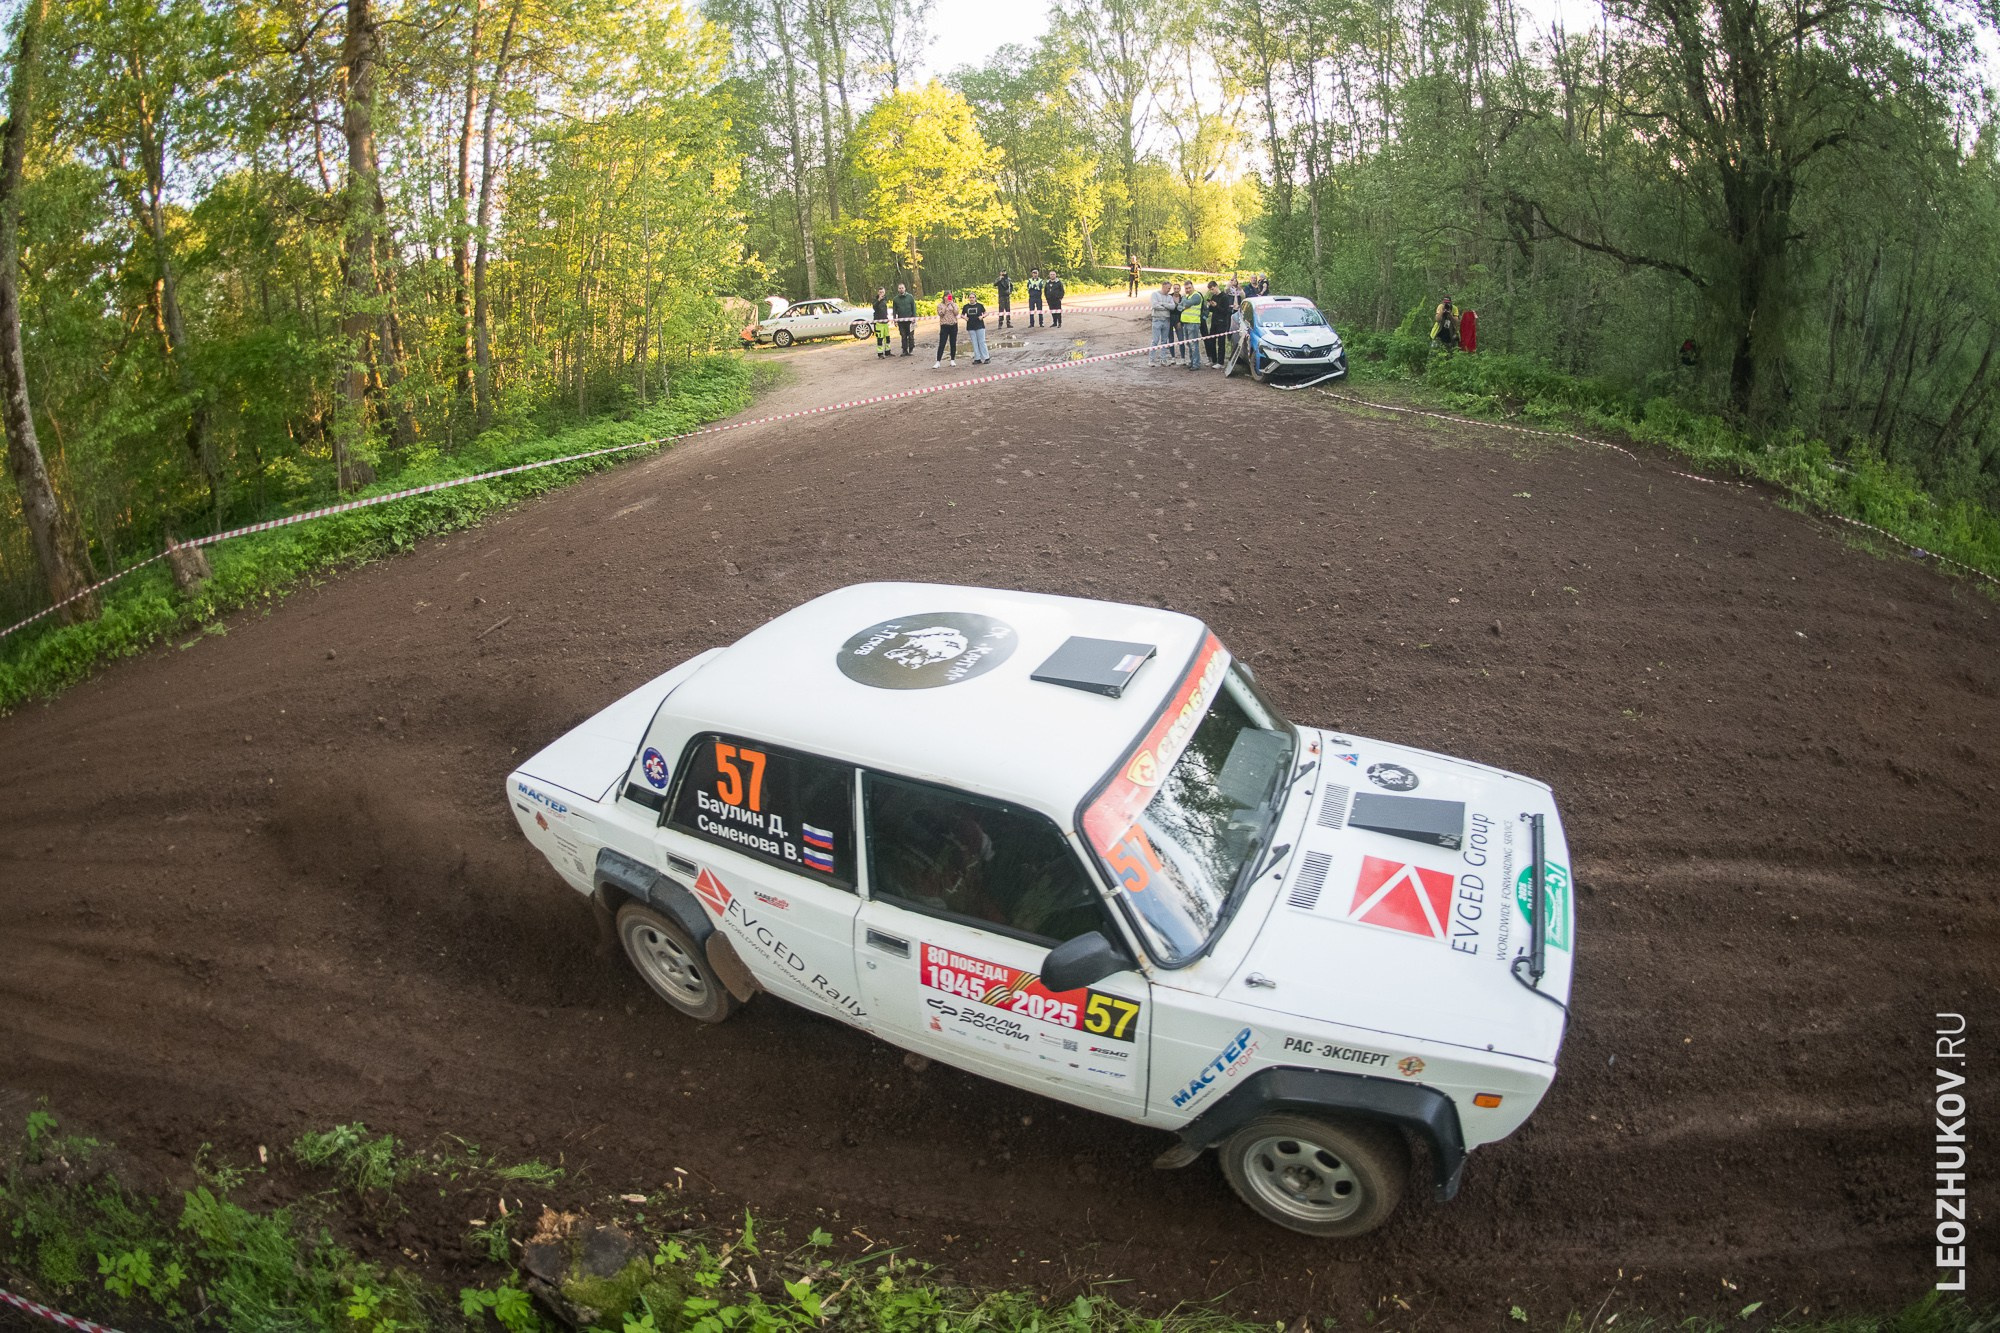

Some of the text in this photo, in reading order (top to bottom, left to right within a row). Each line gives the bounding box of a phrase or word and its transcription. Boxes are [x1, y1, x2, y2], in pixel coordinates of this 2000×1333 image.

[518, 782, 568, 813] МАСТЕР
[715, 743, 767, 812] 57
[697, 790, 789, 840] Баулин Д.
[697, 814, 803, 863] Семенова В.
[1104, 823, 1163, 893] 57
[1451, 812, 1496, 956] EVGED Group
[1496, 820, 1514, 961] WORLDWIDE FORWARDING SERVICE
[728, 898, 867, 1017] EVGED Rally
[927, 946, 1009, 983] 80 ПОБЕДА!
[927, 965, 986, 1002] 1945
[1011, 989, 1078, 1028] 2025
[1084, 993, 1139, 1038] 57
[1171, 1027, 1253, 1109] МАСТЕР
[1226, 1041, 1260, 1078] СПОРТ
[1283, 1037, 1314, 1054] РАС
